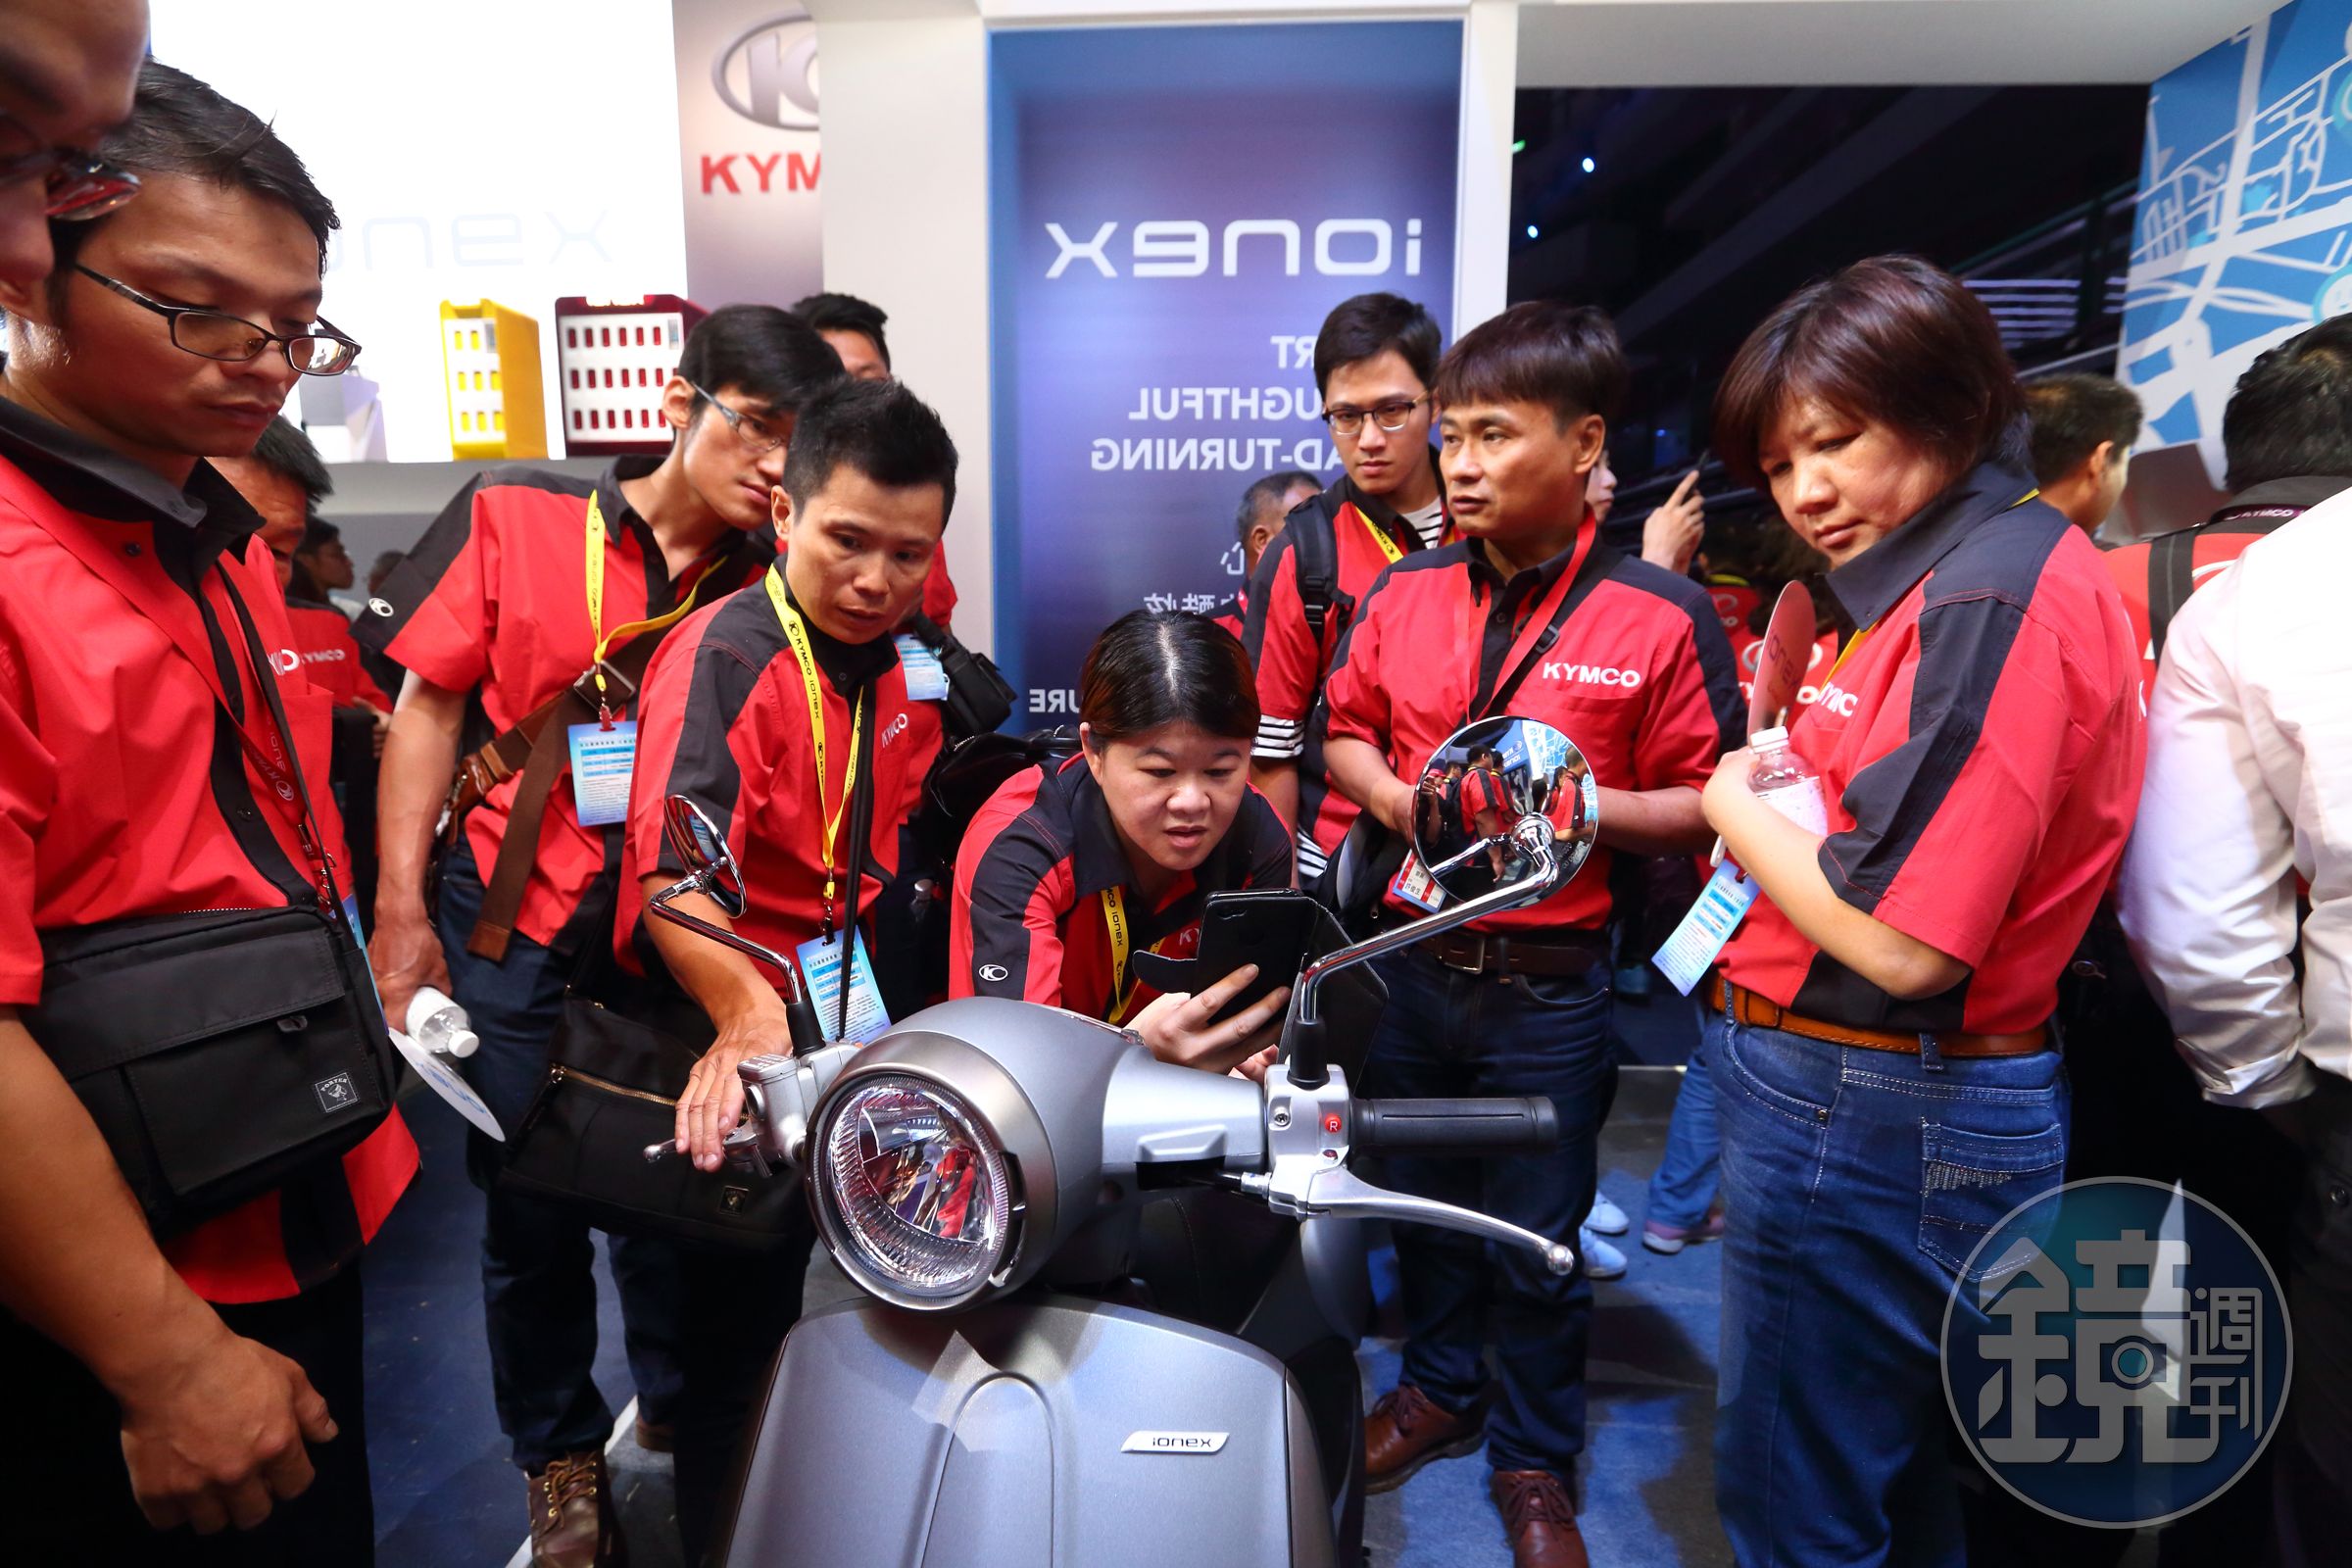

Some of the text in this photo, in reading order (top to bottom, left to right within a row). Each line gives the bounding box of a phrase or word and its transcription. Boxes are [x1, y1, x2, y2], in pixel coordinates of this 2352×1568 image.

[702, 152, 821, 195] KYM
[329, 210, 613, 270] nex
[796, 638, 819, 719] KYMCO ionex
[1543, 662, 1641, 688] KYMCO
[270, 732, 286, 772] ione
[1111, 911, 1123, 946] ionex
[1330, 1120, 1339, 1132] R
[1152, 1437, 1211, 1447] ionex
